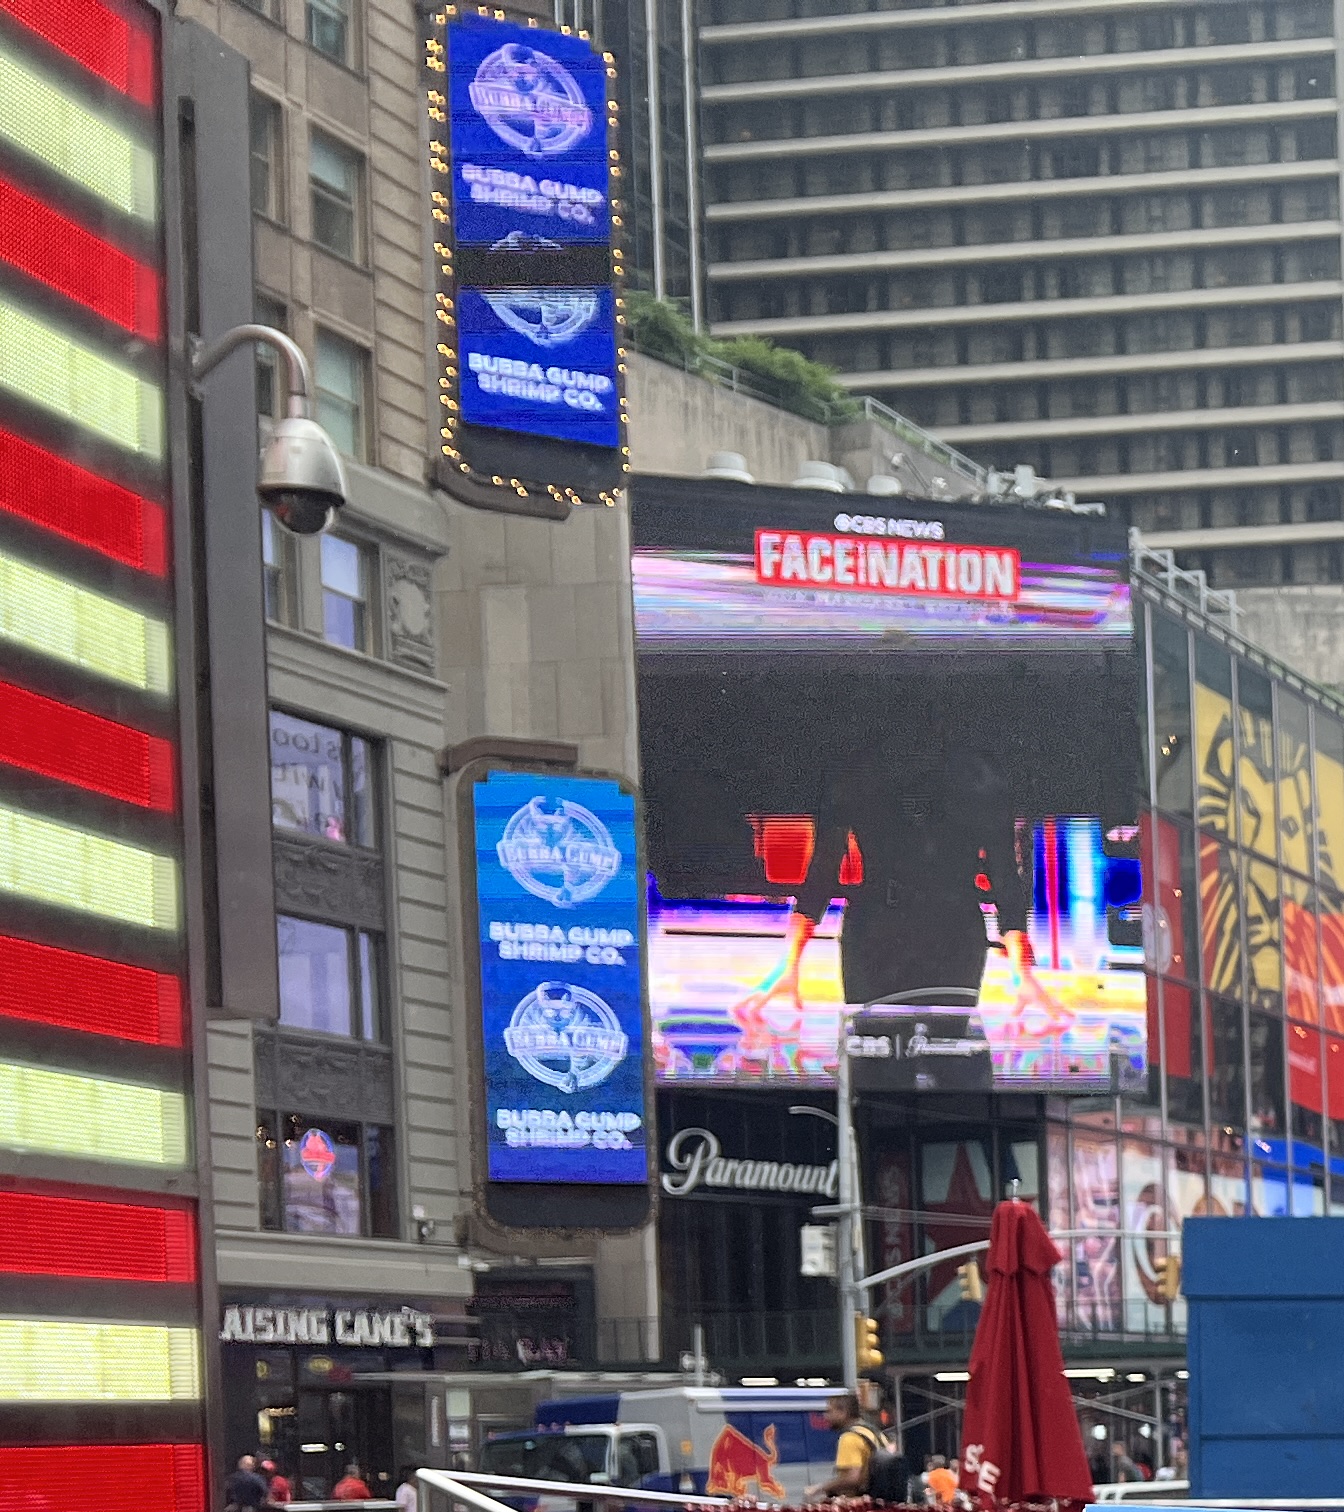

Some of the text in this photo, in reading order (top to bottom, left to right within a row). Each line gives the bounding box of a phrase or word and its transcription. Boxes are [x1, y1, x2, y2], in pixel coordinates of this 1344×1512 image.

[539, 178, 604, 205] GUMP
[468, 352, 614, 394] BUBBA GUMP
[477, 372, 605, 412] SHRIMP CO.
[851, 515, 945, 541] CBS NEWS
[759, 532, 855, 585] FACE
[868, 540, 1016, 597] NATION
[489, 921, 635, 948] BUBBA GUMP
[496, 1108, 642, 1133] BUBBA GUMP
[662, 1127, 839, 1198] Paramount
[218, 1303, 329, 1345] AISING
